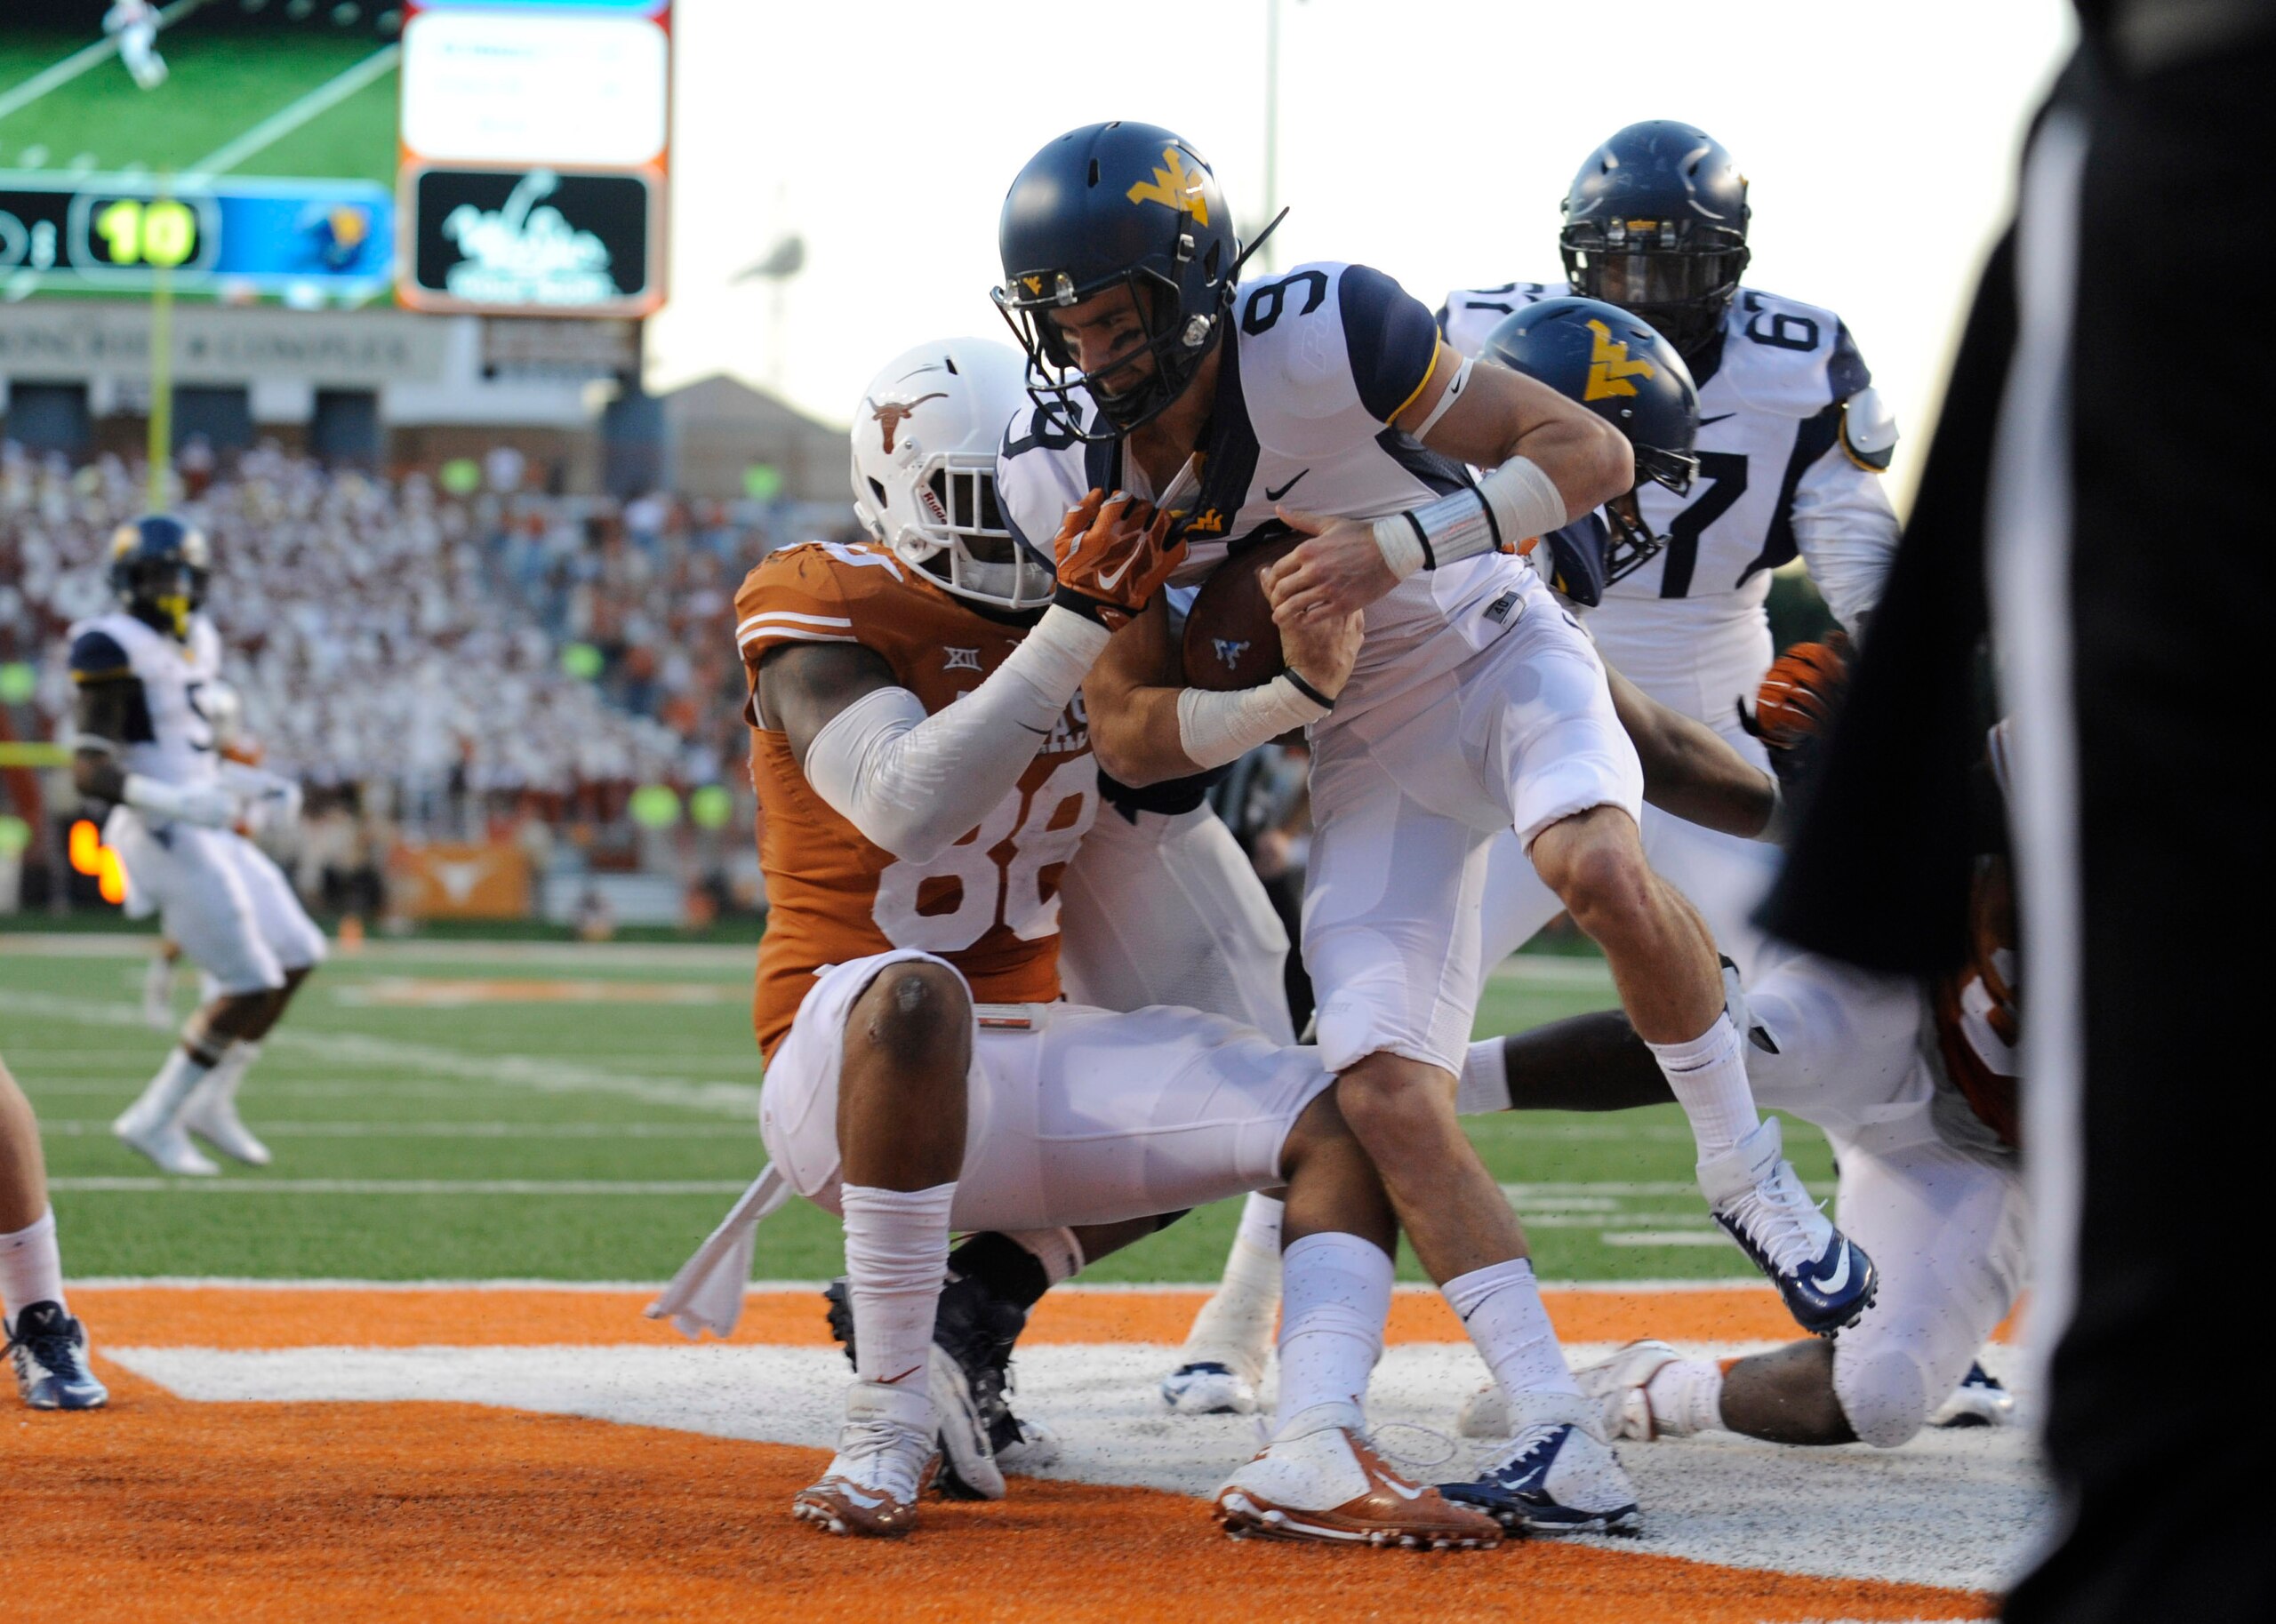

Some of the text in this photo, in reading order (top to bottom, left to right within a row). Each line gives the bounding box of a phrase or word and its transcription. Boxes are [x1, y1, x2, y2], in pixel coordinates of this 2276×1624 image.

[98, 199, 196, 266] 10
[1242, 269, 1329, 337] 9
[923, 491, 949, 526] Ridde
[1659, 451, 1749, 599] 7
[1494, 600, 1510, 615] 40
[942, 645, 984, 673] XII
[871, 751, 1100, 952] 88
